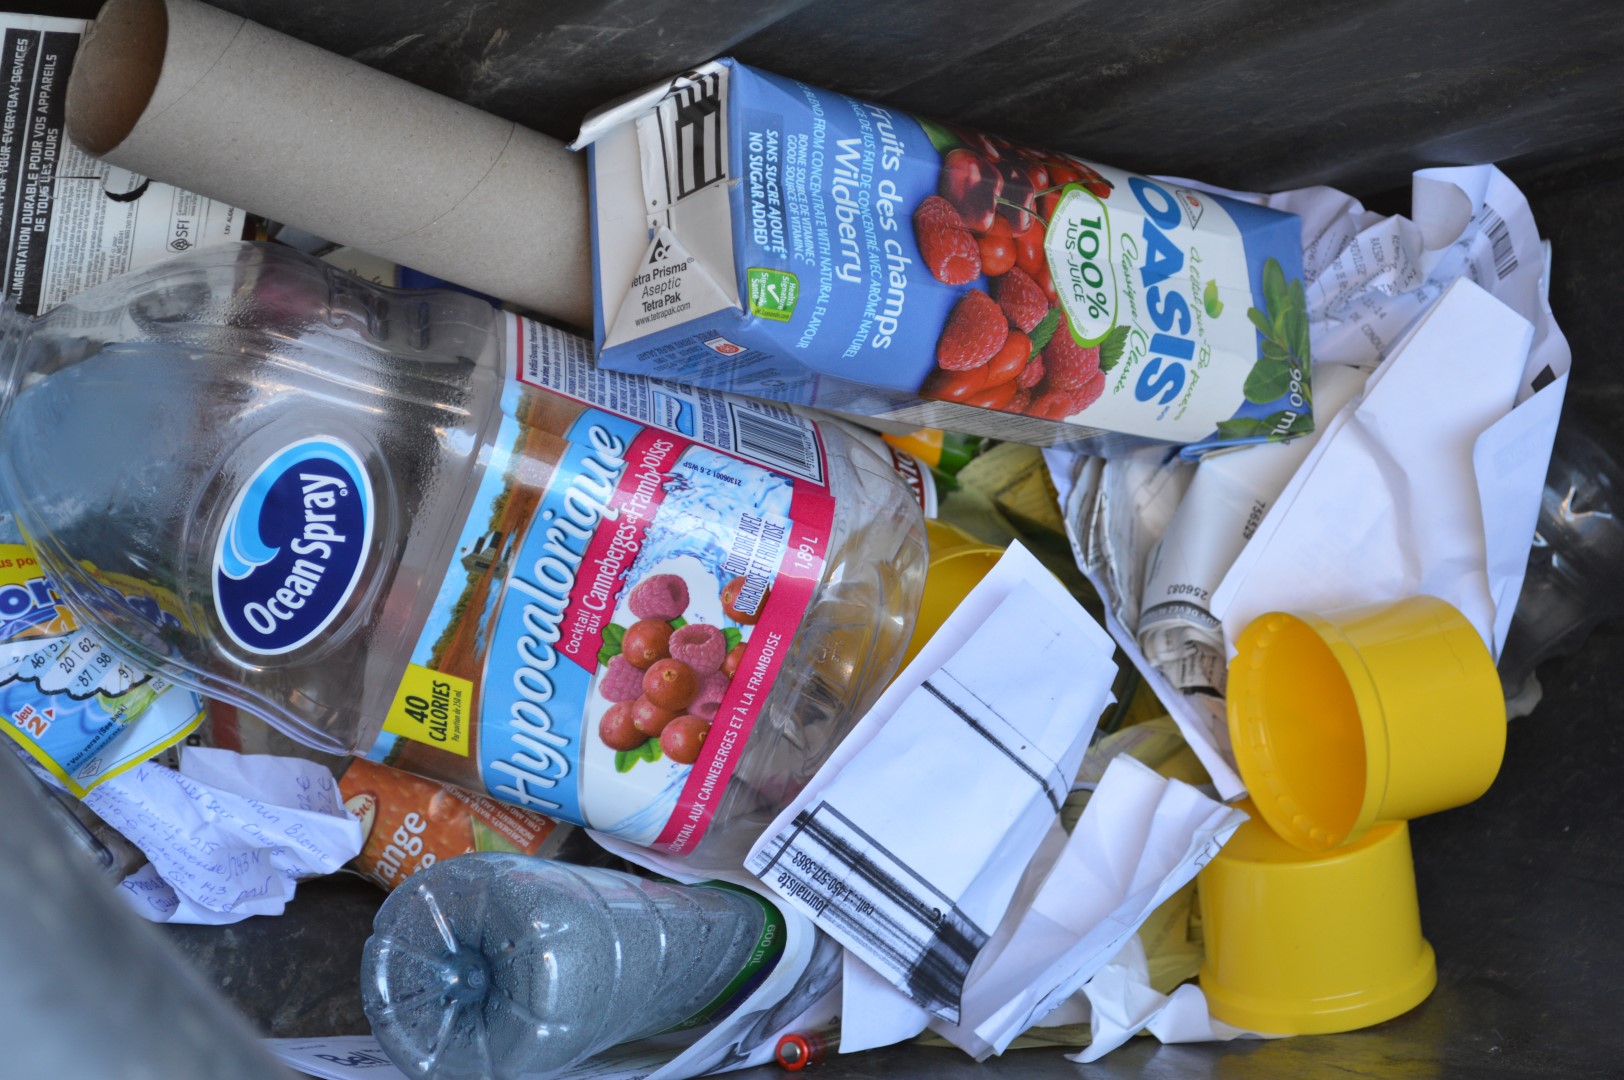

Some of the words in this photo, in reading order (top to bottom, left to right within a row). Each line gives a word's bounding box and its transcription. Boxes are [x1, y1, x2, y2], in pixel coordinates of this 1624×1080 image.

[2, 84, 20, 143] EVERYDAY
[11, 37, 28, 83] DEVICES
[37, 52, 57, 114] APPAREILS
[33, 115, 46, 138] VOS
[43, 126, 59, 161] JOURS
[748, 131, 762, 152] NO
[811, 117, 827, 147] FROM
[861, 131, 874, 148] JUS
[864, 103, 905, 171] Fruits
[29, 139, 43, 170] POUR
[764, 128, 779, 162] SANS
[785, 134, 797, 162] GOOD
[796, 133, 809, 166] BONNE
[861, 149, 876, 171] FAIT
[748, 154, 763, 198] SUGAR
[765, 163, 780, 205] SUCRE
[808, 150, 827, 227] CONCENTRATE
[858, 173, 870, 188] DE
[20, 172, 39, 224] DURABLE
[35, 184, 51, 215] TOUS
[787, 202, 798, 214] OF
[798, 203, 809, 216] DE
[829, 137, 867, 284] Wildberry
[876, 178, 904, 232] des
[33, 216, 46, 232] DE
[175, 219, 189, 237] SFI
[789, 214, 802, 250] VITAMIN
[801, 216, 814, 256] VITAMINE
[856, 190, 880, 250] CONCENTRÉ
[793, 251, 803, 260] C
[816, 228, 830, 255] WITH
[9, 226, 32, 304] ALIMENTATION
[804, 257, 815, 266] C
[866, 251, 882, 279] AVEC
[1076, 215, 1110, 320] 100%
[641, 276, 681, 299] Aseptic
[776, 275, 790, 310] Signature
[785, 281, 796, 306] Health
[814, 256, 833, 305] NATURAL
[862, 278, 883, 317] ARÔME
[872, 237, 908, 350] champs
[1127, 176, 1196, 406] OASIS
[635, 302, 691, 327] www.tetrapak.com
[642, 295, 664, 313] Tetra
[664, 292, 681, 309] Pak
[795, 306, 826, 348] FLAVOUR
[841, 320, 873, 357] NATUREL
[1288, 367, 1303, 407] 960
[736, 512, 762, 536] AVEC
[754, 520, 786, 562] FRUCTOSE
[801, 532, 818, 544] L
[583, 522, 637, 611] Canneberges
[721, 530, 756, 576] ÉDULCORÉ
[751, 560, 773, 573] ET
[792, 542, 818, 571] 1,89
[244, 557, 325, 635] Ocean
[733, 568, 769, 616] SUCRALOSE
[491, 424, 624, 810] Hypocalorique
[565, 608, 590, 654] Cocktail
[586, 614, 601, 635] aux
[59, 656, 75, 674] 20
[78, 637, 96, 653] 62
[78, 669, 94, 688] 87
[97, 651, 112, 669] 98
[746, 629, 782, 692] FRAMBOISE
[14, 705, 33, 726] Jeu
[400, 693, 431, 724] 40
[428, 680, 448, 739] CALORIES
[733, 703, 748, 715] À
[739, 690, 755, 706] LA
[27, 715, 48, 738] 2
[729, 713, 744, 729] ET
[70, 751, 83, 764] Voir
[83, 735, 100, 752] verso
[697, 727, 738, 802] CANNEBERGES
[668, 813, 697, 854] COCKTAIL
[689, 797, 706, 823] AUX
[365, 809, 428, 889] range
[789, 849, 855, 902] 1-450-577-3863
[772, 870, 830, 919] Journaliste
[853, 897, 875, 918] cell.
[760, 924, 775, 946] 600
[749, 950, 764, 966] mL
